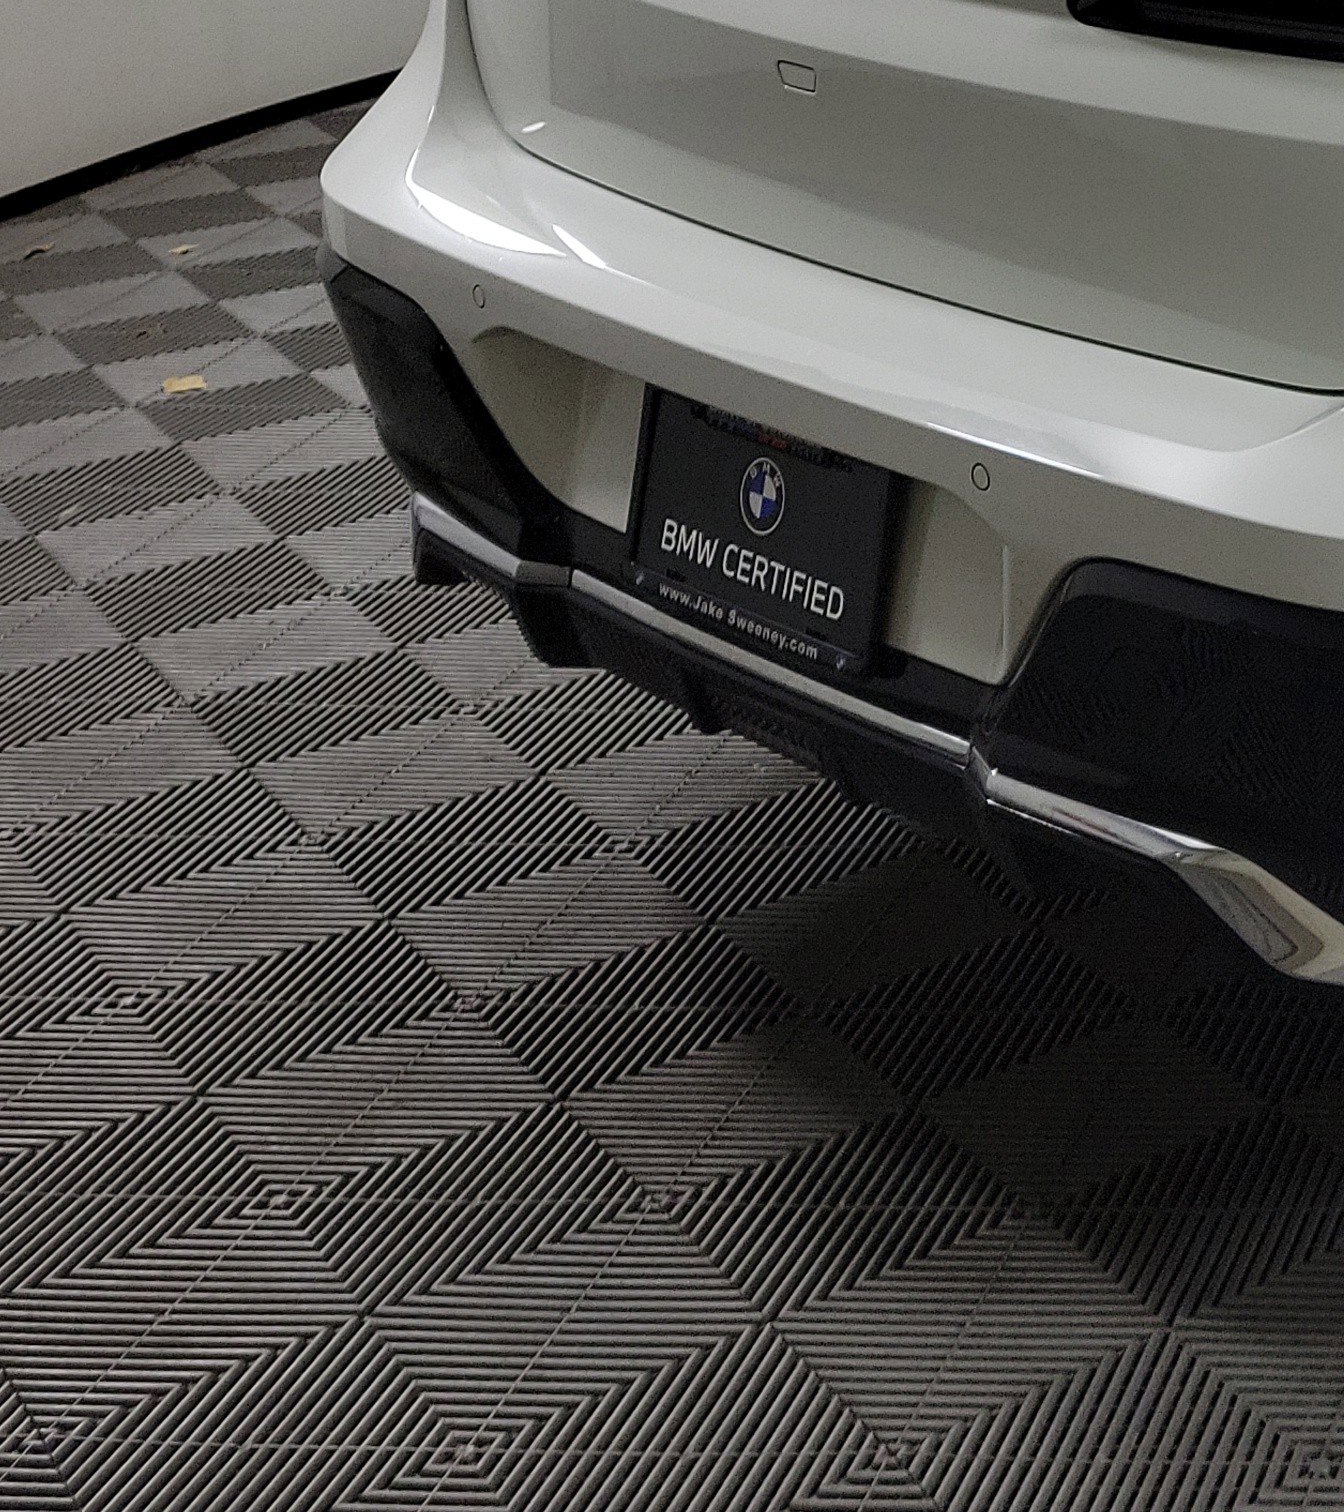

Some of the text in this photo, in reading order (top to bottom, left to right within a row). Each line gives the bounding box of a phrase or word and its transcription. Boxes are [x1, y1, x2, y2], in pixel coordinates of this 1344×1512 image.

[750, 462, 782, 488] BMW
[661, 518, 844, 621] BMW CERTIFIED
